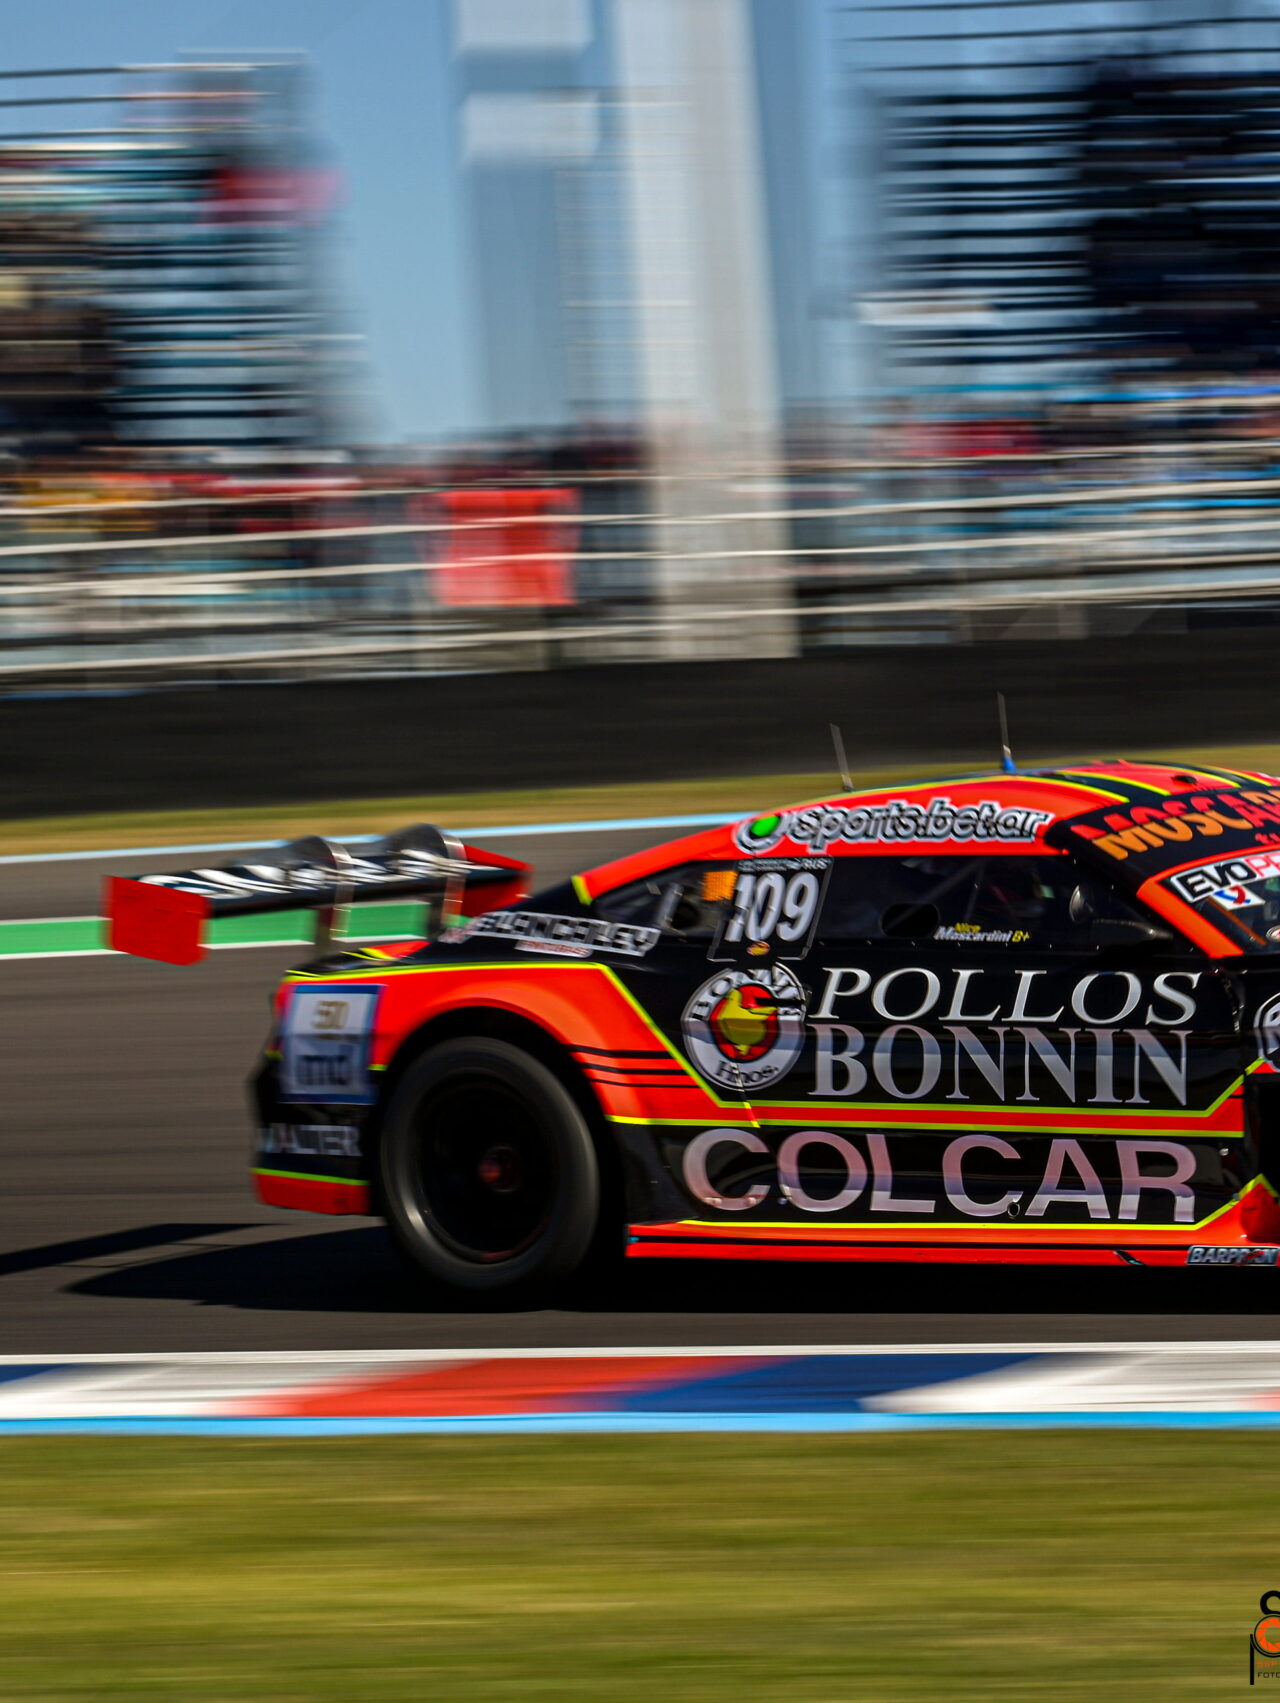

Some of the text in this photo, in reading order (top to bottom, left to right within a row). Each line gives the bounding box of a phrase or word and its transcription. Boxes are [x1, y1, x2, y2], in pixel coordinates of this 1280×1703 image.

[724, 872, 820, 942] 109
[808, 967, 1202, 1025] POLLOS
[808, 1022, 1195, 1106] BONNIN
[682, 1127, 1197, 1223] COLCAR
